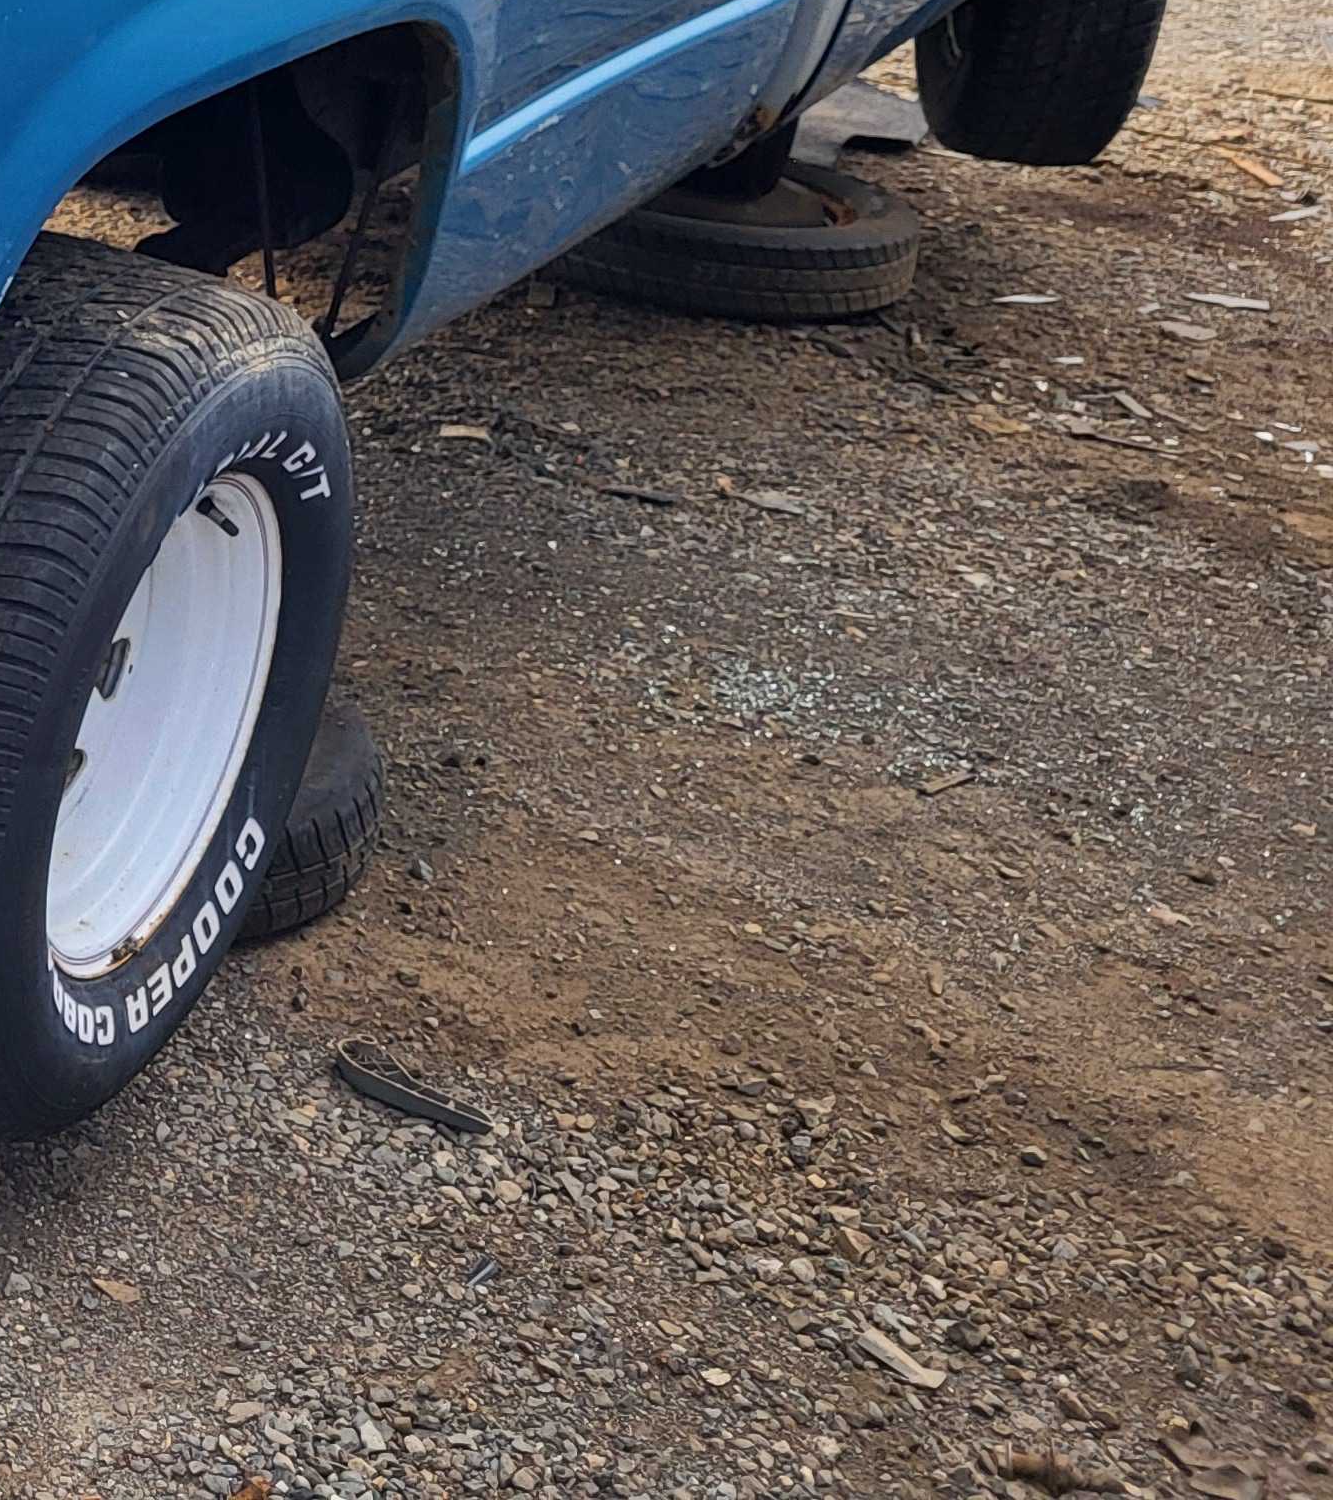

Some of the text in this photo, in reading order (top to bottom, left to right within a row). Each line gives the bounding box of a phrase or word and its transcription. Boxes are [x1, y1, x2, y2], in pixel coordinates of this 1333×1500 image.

[282, 440, 332, 501] G/T
[47, 816, 266, 1046] COOPER COBR
